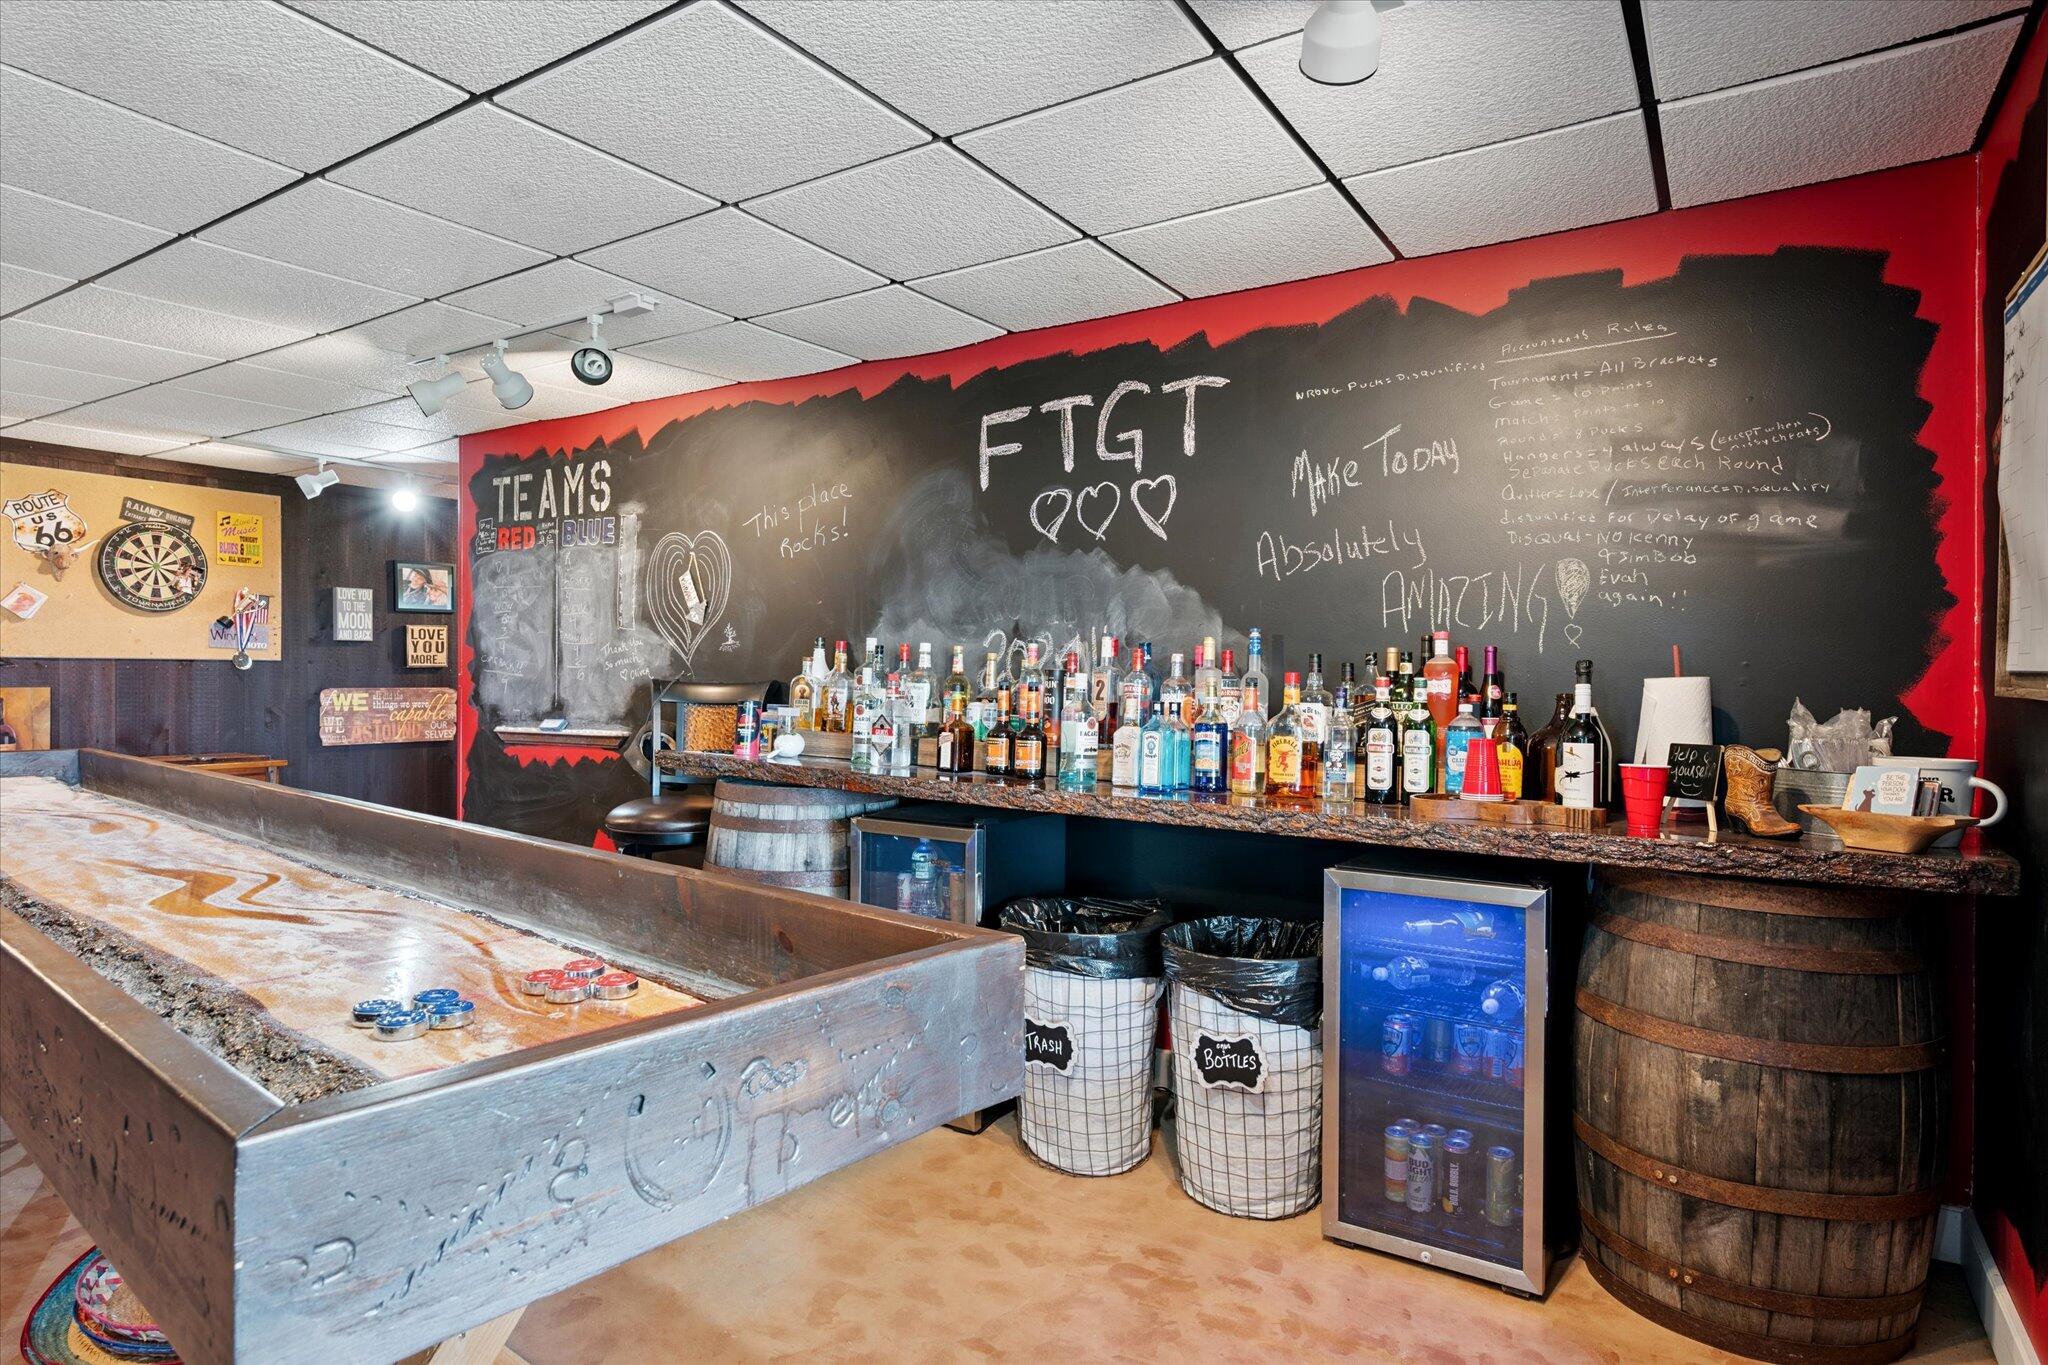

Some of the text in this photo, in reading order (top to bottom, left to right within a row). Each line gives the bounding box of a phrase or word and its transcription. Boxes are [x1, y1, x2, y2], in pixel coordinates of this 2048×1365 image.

[979, 375, 1232, 492] FTGT
[492, 459, 613, 523] TEAMS
[12, 494, 61, 516] ROUTE
[742, 482, 853, 537] This place
[35, 521, 74, 547] 66
[221, 526, 257, 537] Music
[497, 526, 536, 551] RED
[561, 516, 616, 547] BLUE
[1256, 519, 1427, 582] Absolutely
[337, 588, 373, 601] LOVE YOU
[342, 601, 366, 611] TO THE
[338, 612, 372, 630] MOON
[338, 629, 372, 640] AND BACK
[410, 628, 445, 641] LOVE
[411, 640, 445, 654] YOU
[1095, 680, 1105, 701] 2
[332, 692, 369, 712] WE
[372, 700, 399, 710] things
[399, 701, 410, 709] we
[323, 715, 345, 734] WE
[389, 693, 449, 740] capable
[351, 718, 448, 742] ASTOUND OUR
[424, 729, 455, 739] SELVES
[1272, 738, 1298, 749] FIREBALL
[1671, 745, 1698, 763] Help
[1025, 1031, 1063, 1057] TRASH
[1203, 1047, 1257, 1071] BOTTLES
